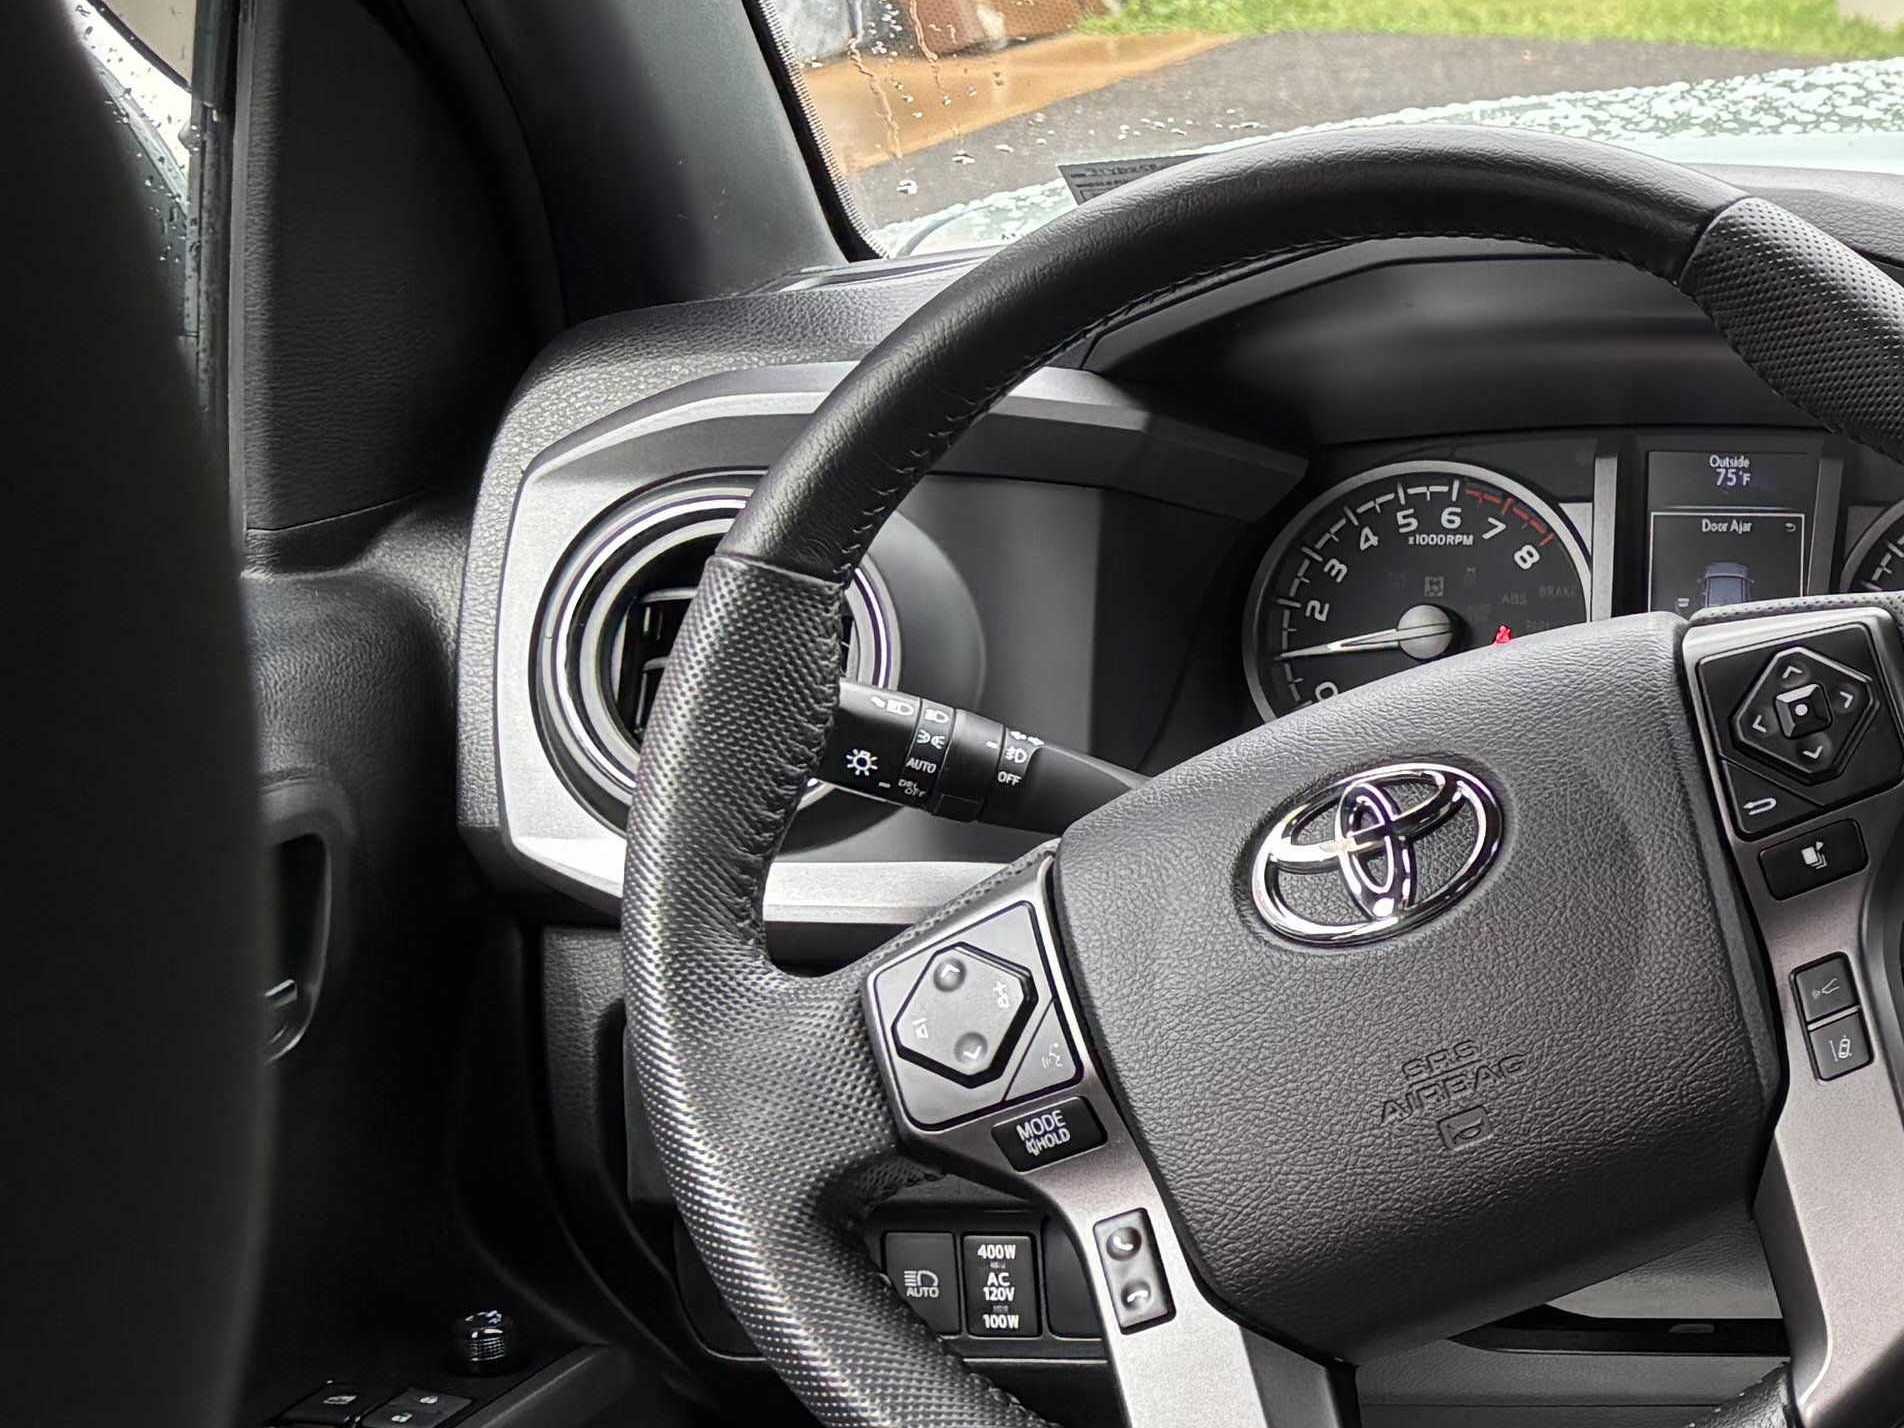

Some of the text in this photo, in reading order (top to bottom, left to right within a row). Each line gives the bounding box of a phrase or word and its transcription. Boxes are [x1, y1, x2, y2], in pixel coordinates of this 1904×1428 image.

[1709, 454, 1750, 469] Outside
[1396, 508, 1419, 534] 5
[1441, 506, 1462, 529] 6
[1702, 518, 1752, 535] Door Ajar
[1359, 526, 1380, 551] 4
[1482, 516, 1507, 541] 7
[1513, 544, 1541, 570] 8
[1323, 558, 1349, 584] 3
[1305, 599, 1331, 623] 2
[905, 757, 938, 775] AUTO
[997, 770, 1023, 787] OFF
[1016, 1109, 1067, 1142] MODE
[1036, 1127, 1072, 1153] HOLD
[977, 1244, 1016, 1260] 400W
[987, 1272, 1010, 1287] AC
[906, 1284, 939, 1299] AUTO
[983, 1286, 1015, 1302] 120V
[983, 1314, 1019, 1330] 100W
